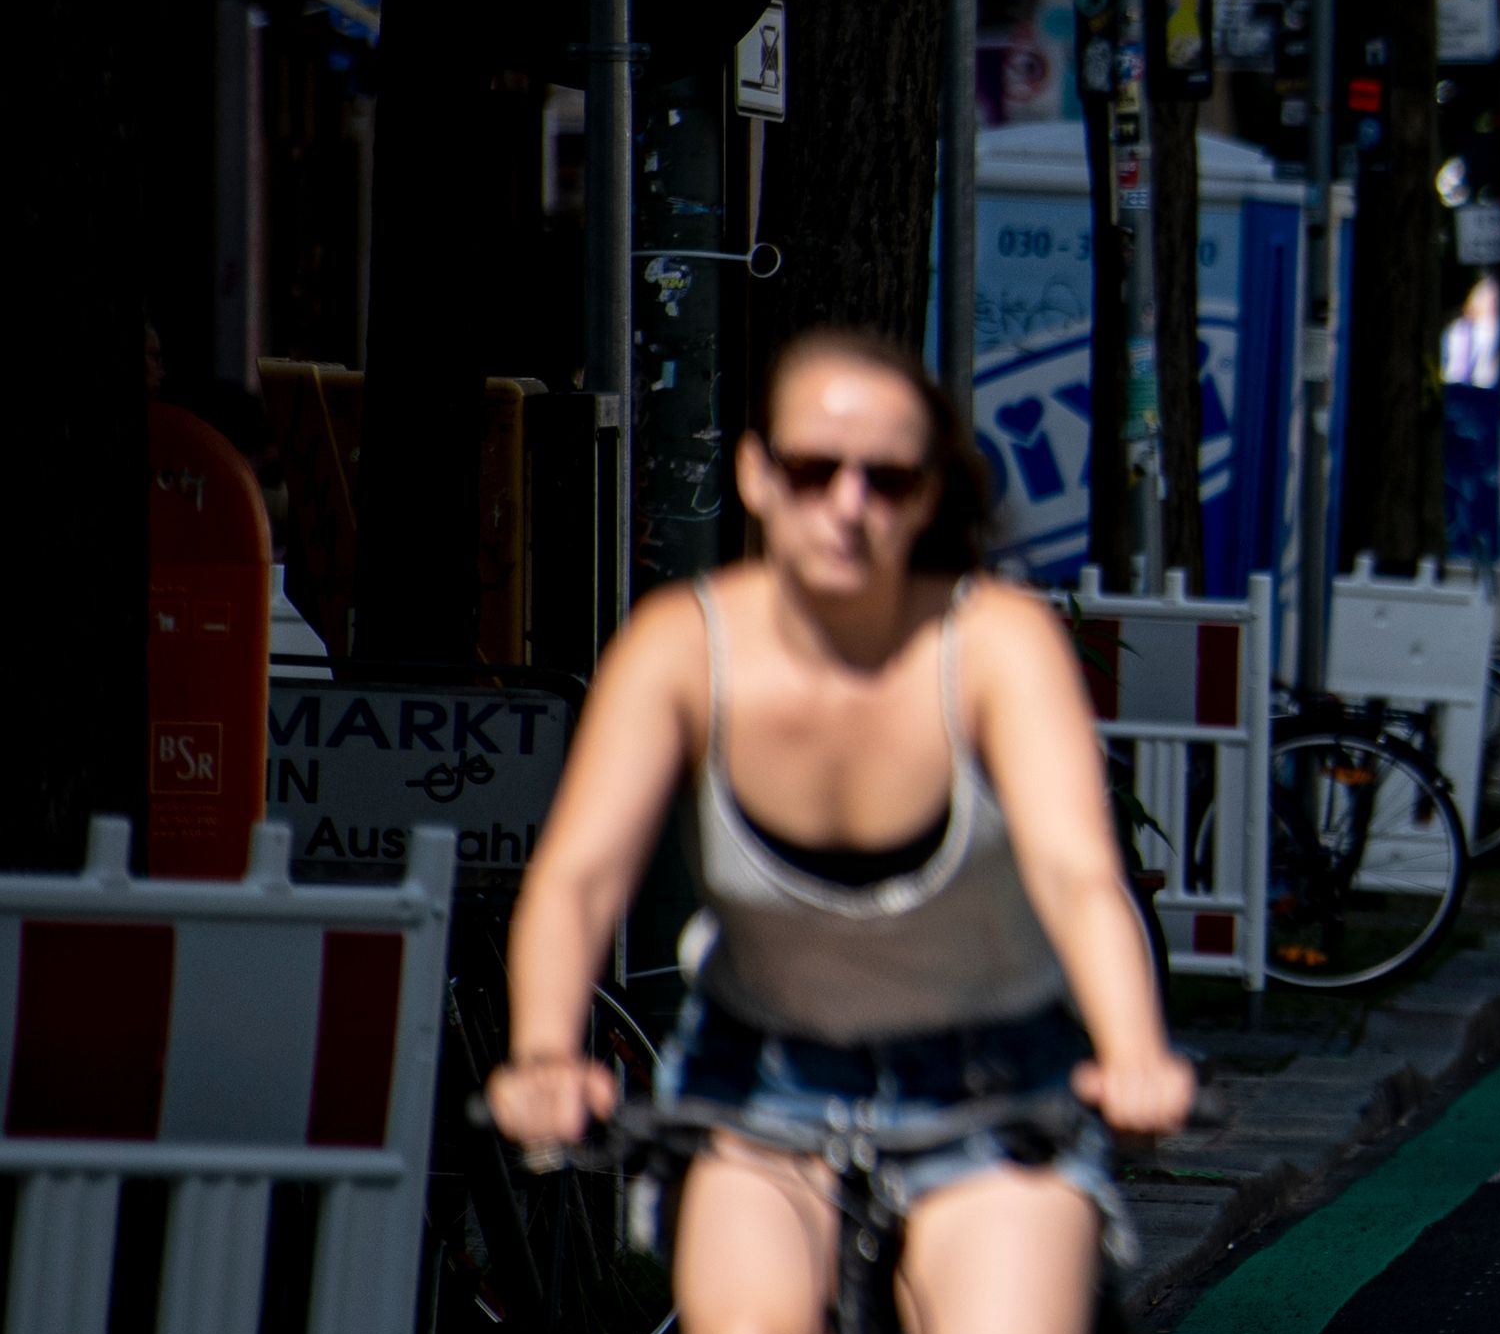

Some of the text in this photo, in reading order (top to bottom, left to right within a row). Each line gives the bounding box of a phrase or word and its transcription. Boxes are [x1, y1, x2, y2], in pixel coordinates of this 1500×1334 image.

[269, 697, 548, 754] MARKT
[159, 734, 217, 781] BSR
[304, 818, 536, 864] Ausahl
